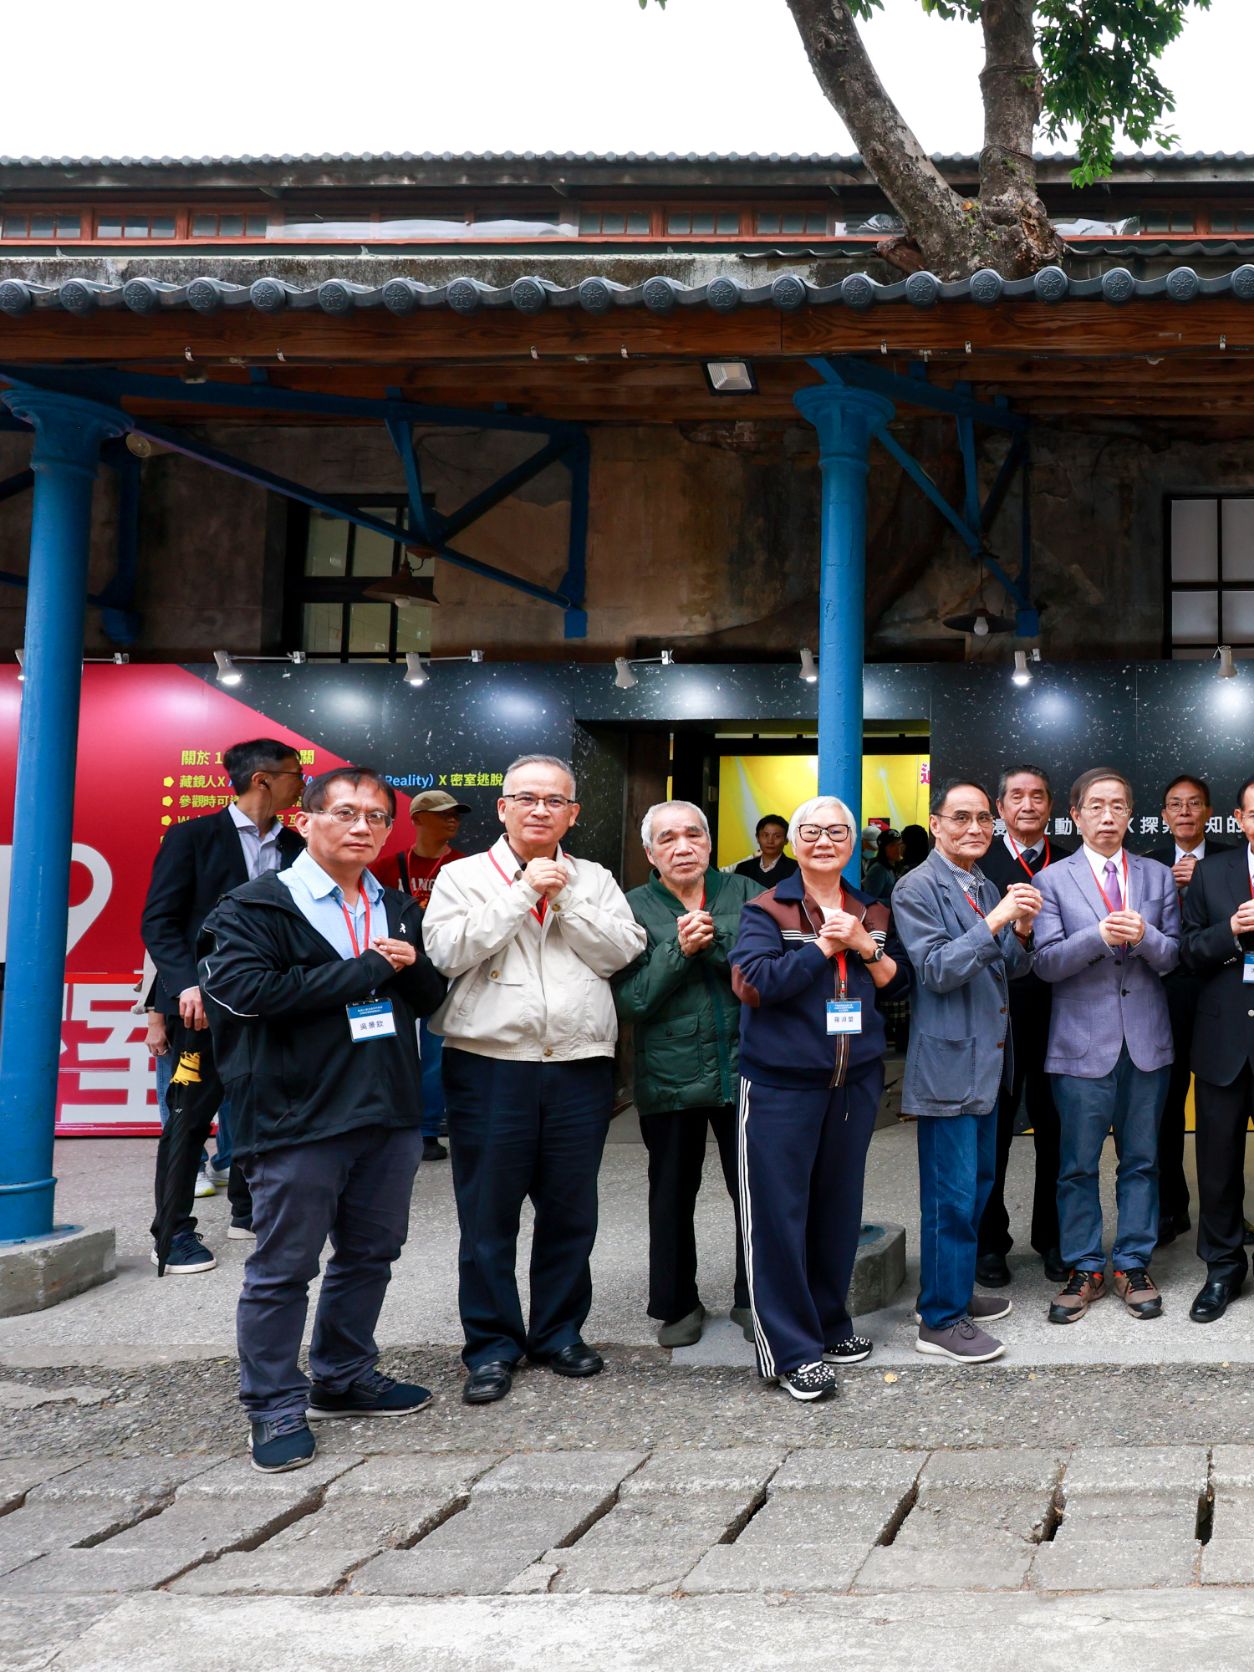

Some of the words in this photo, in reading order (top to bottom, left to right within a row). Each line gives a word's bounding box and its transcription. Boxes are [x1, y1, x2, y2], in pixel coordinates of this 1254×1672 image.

[181, 750, 211, 765] 關於
[438, 774, 448, 786] X
[450, 773, 504, 787] 密室逃脫
